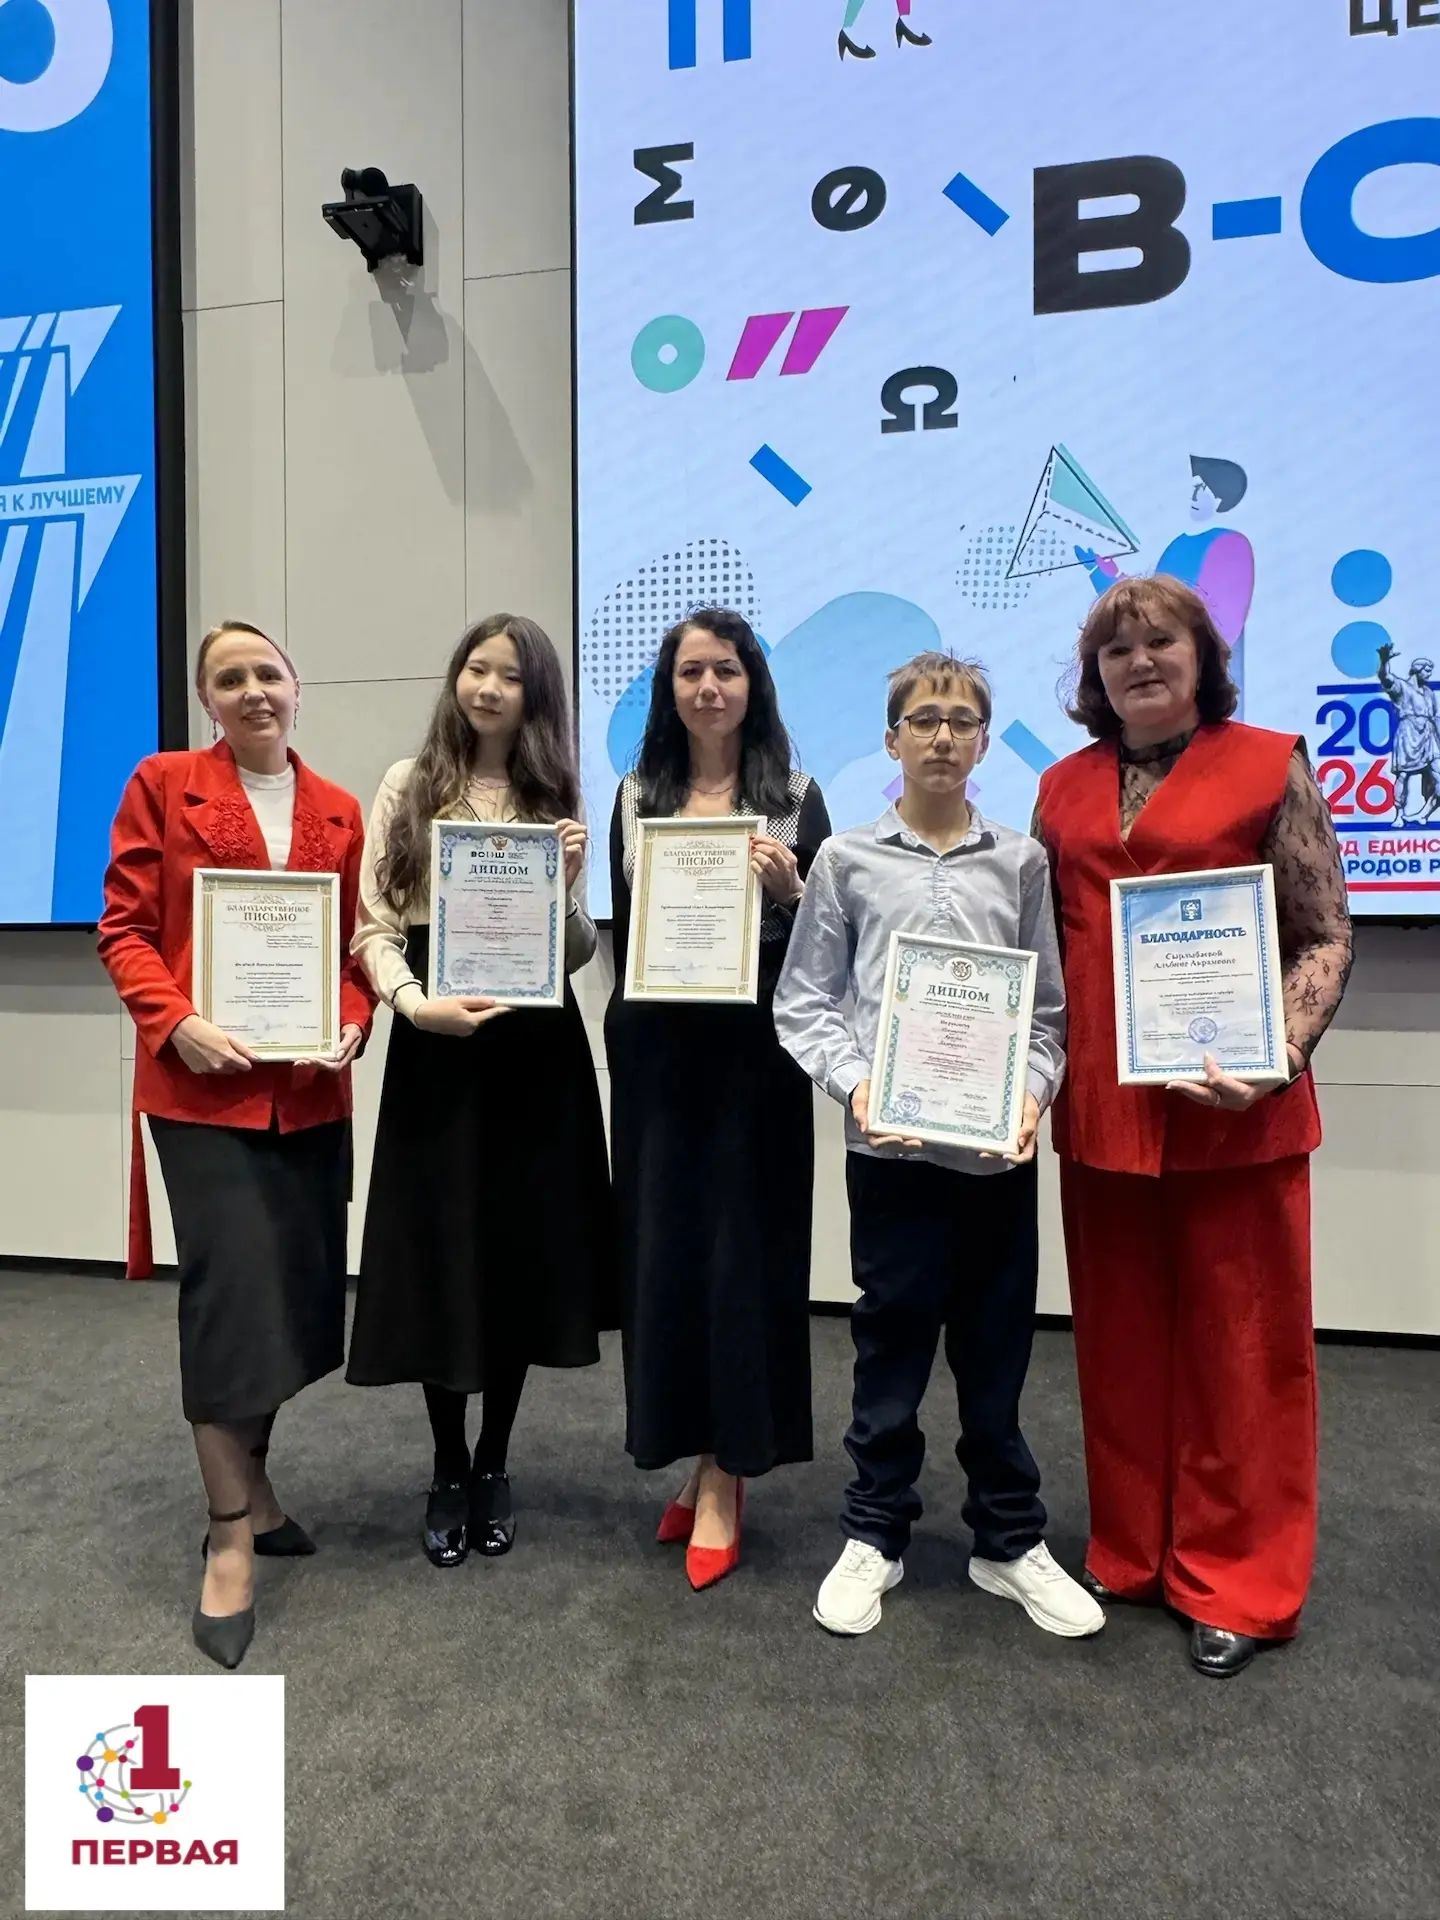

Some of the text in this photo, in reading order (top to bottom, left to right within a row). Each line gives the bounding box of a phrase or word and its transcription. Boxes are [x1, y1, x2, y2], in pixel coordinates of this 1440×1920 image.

[12, 493, 25, 512] К
[29, 484, 125, 510] ЛУЧШЕМУ
[1316, 698, 1400, 757] 20
[1316, 759, 1395, 815] 26
[1367, 838, 1440, 857] ЕДИНС
[468, 864, 529, 876] ДИПЛОМ
[677, 856, 725, 867] ПИСЬМО
[243, 912, 297, 922] ПИСЬМО
[1140, 927, 1247, 944] БЛАГОДАРНОСТЬ
[926, 984, 991, 1003] ДИПЛОМ
